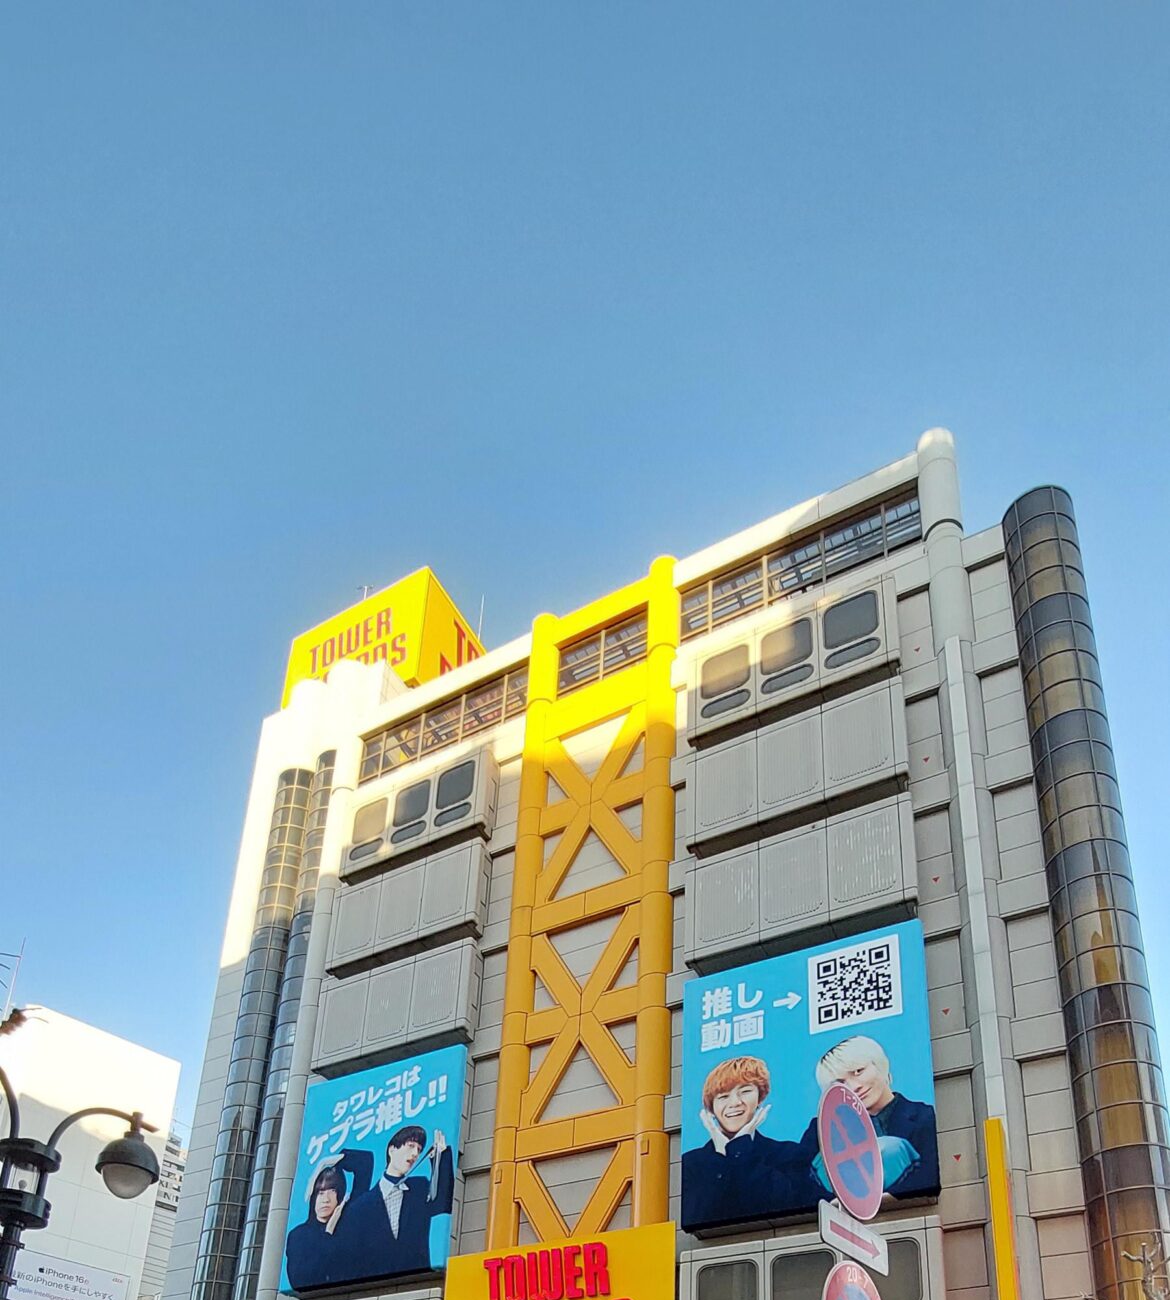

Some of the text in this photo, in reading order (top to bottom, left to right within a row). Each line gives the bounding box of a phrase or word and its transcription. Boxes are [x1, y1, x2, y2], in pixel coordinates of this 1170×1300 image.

[310, 608, 392, 674] TOWER
[702, 983, 763, 1020] 推し
[701, 1010, 765, 1052] 動画
[332, 1065, 422, 1122] タワレコは
[840, 1088, 863, 1116] 7-20
[45, 1267, 74, 1281] iPhone
